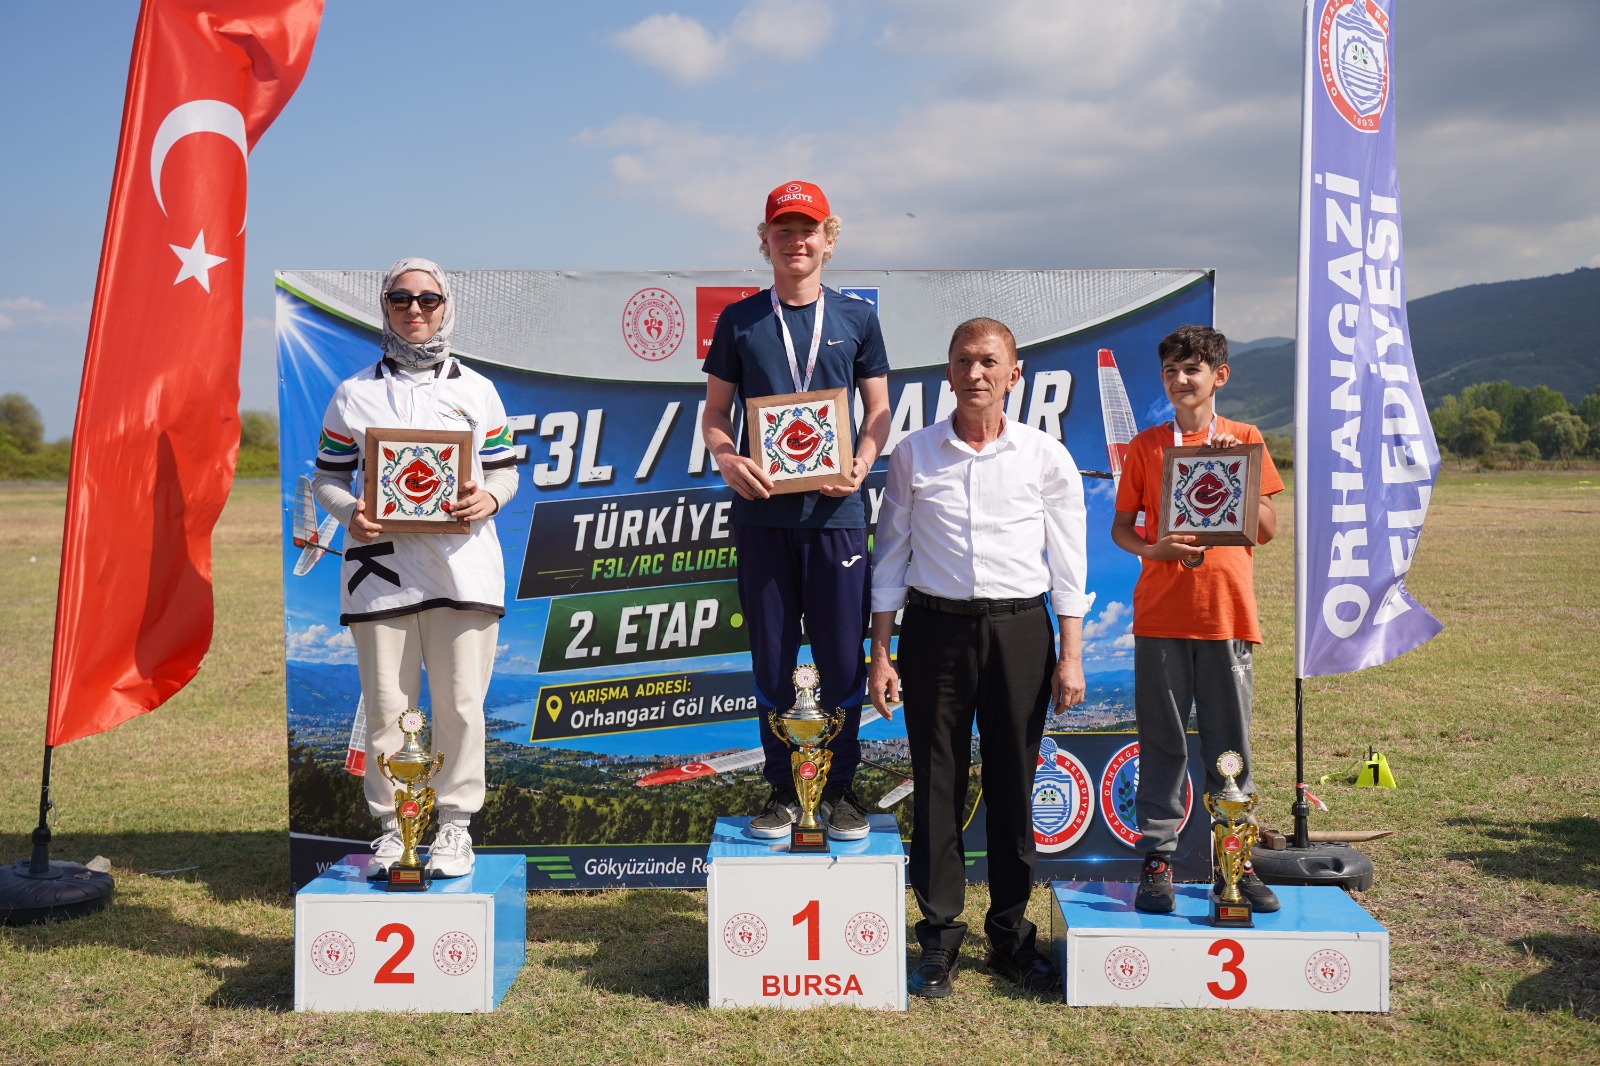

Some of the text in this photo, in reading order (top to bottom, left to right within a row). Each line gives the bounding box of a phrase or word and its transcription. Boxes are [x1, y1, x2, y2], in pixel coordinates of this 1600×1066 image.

[1353, 115, 1374, 127] 1893
[1315, 172, 1370, 638] ORHANGAZİ
[573, 497, 732, 551] TÜRKİYE
[591, 553, 665, 580] F3L/RC
[564, 599, 719, 659] 2. ETAP
[569, 676, 692, 705] YARIŞMA ADRESİ:
[570, 701, 666, 729] Orhangazi
[673, 696, 704, 717] Göl
[1368, 764, 1379, 786] 1
[1108, 812, 1135, 840] SPOR
[584, 857, 686, 879] Gökyüzünde
[792, 900, 820, 960] 1
[373, 923, 415, 984] 2
[1207, 938, 1247, 1000] 3
[762, 974, 863, 996] BURSA
